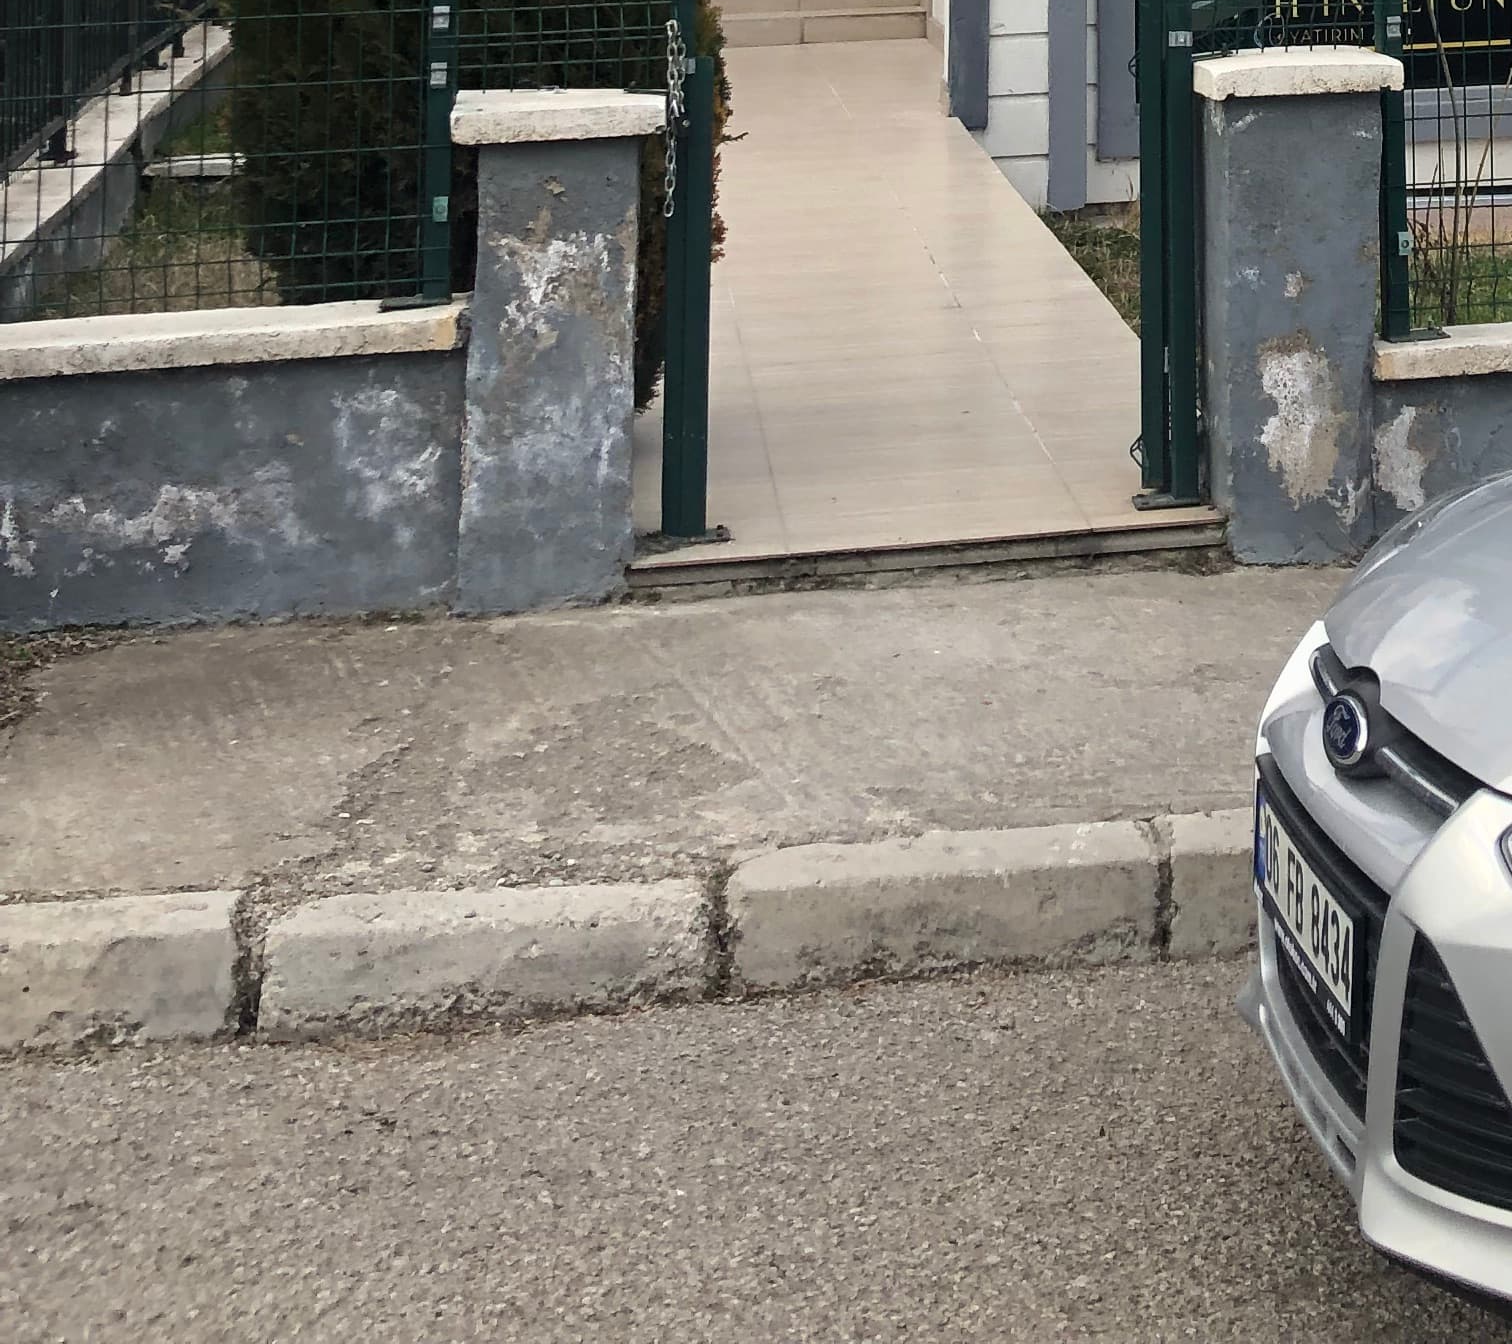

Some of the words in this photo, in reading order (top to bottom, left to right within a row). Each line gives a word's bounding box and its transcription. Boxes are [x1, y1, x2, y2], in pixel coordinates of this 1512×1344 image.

[1289, 25, 1365, 45] YATIRIM
[1265, 813, 1280, 896] 06
[1287, 846, 1304, 936] FB
[1311, 883, 1351, 1003] 8434
